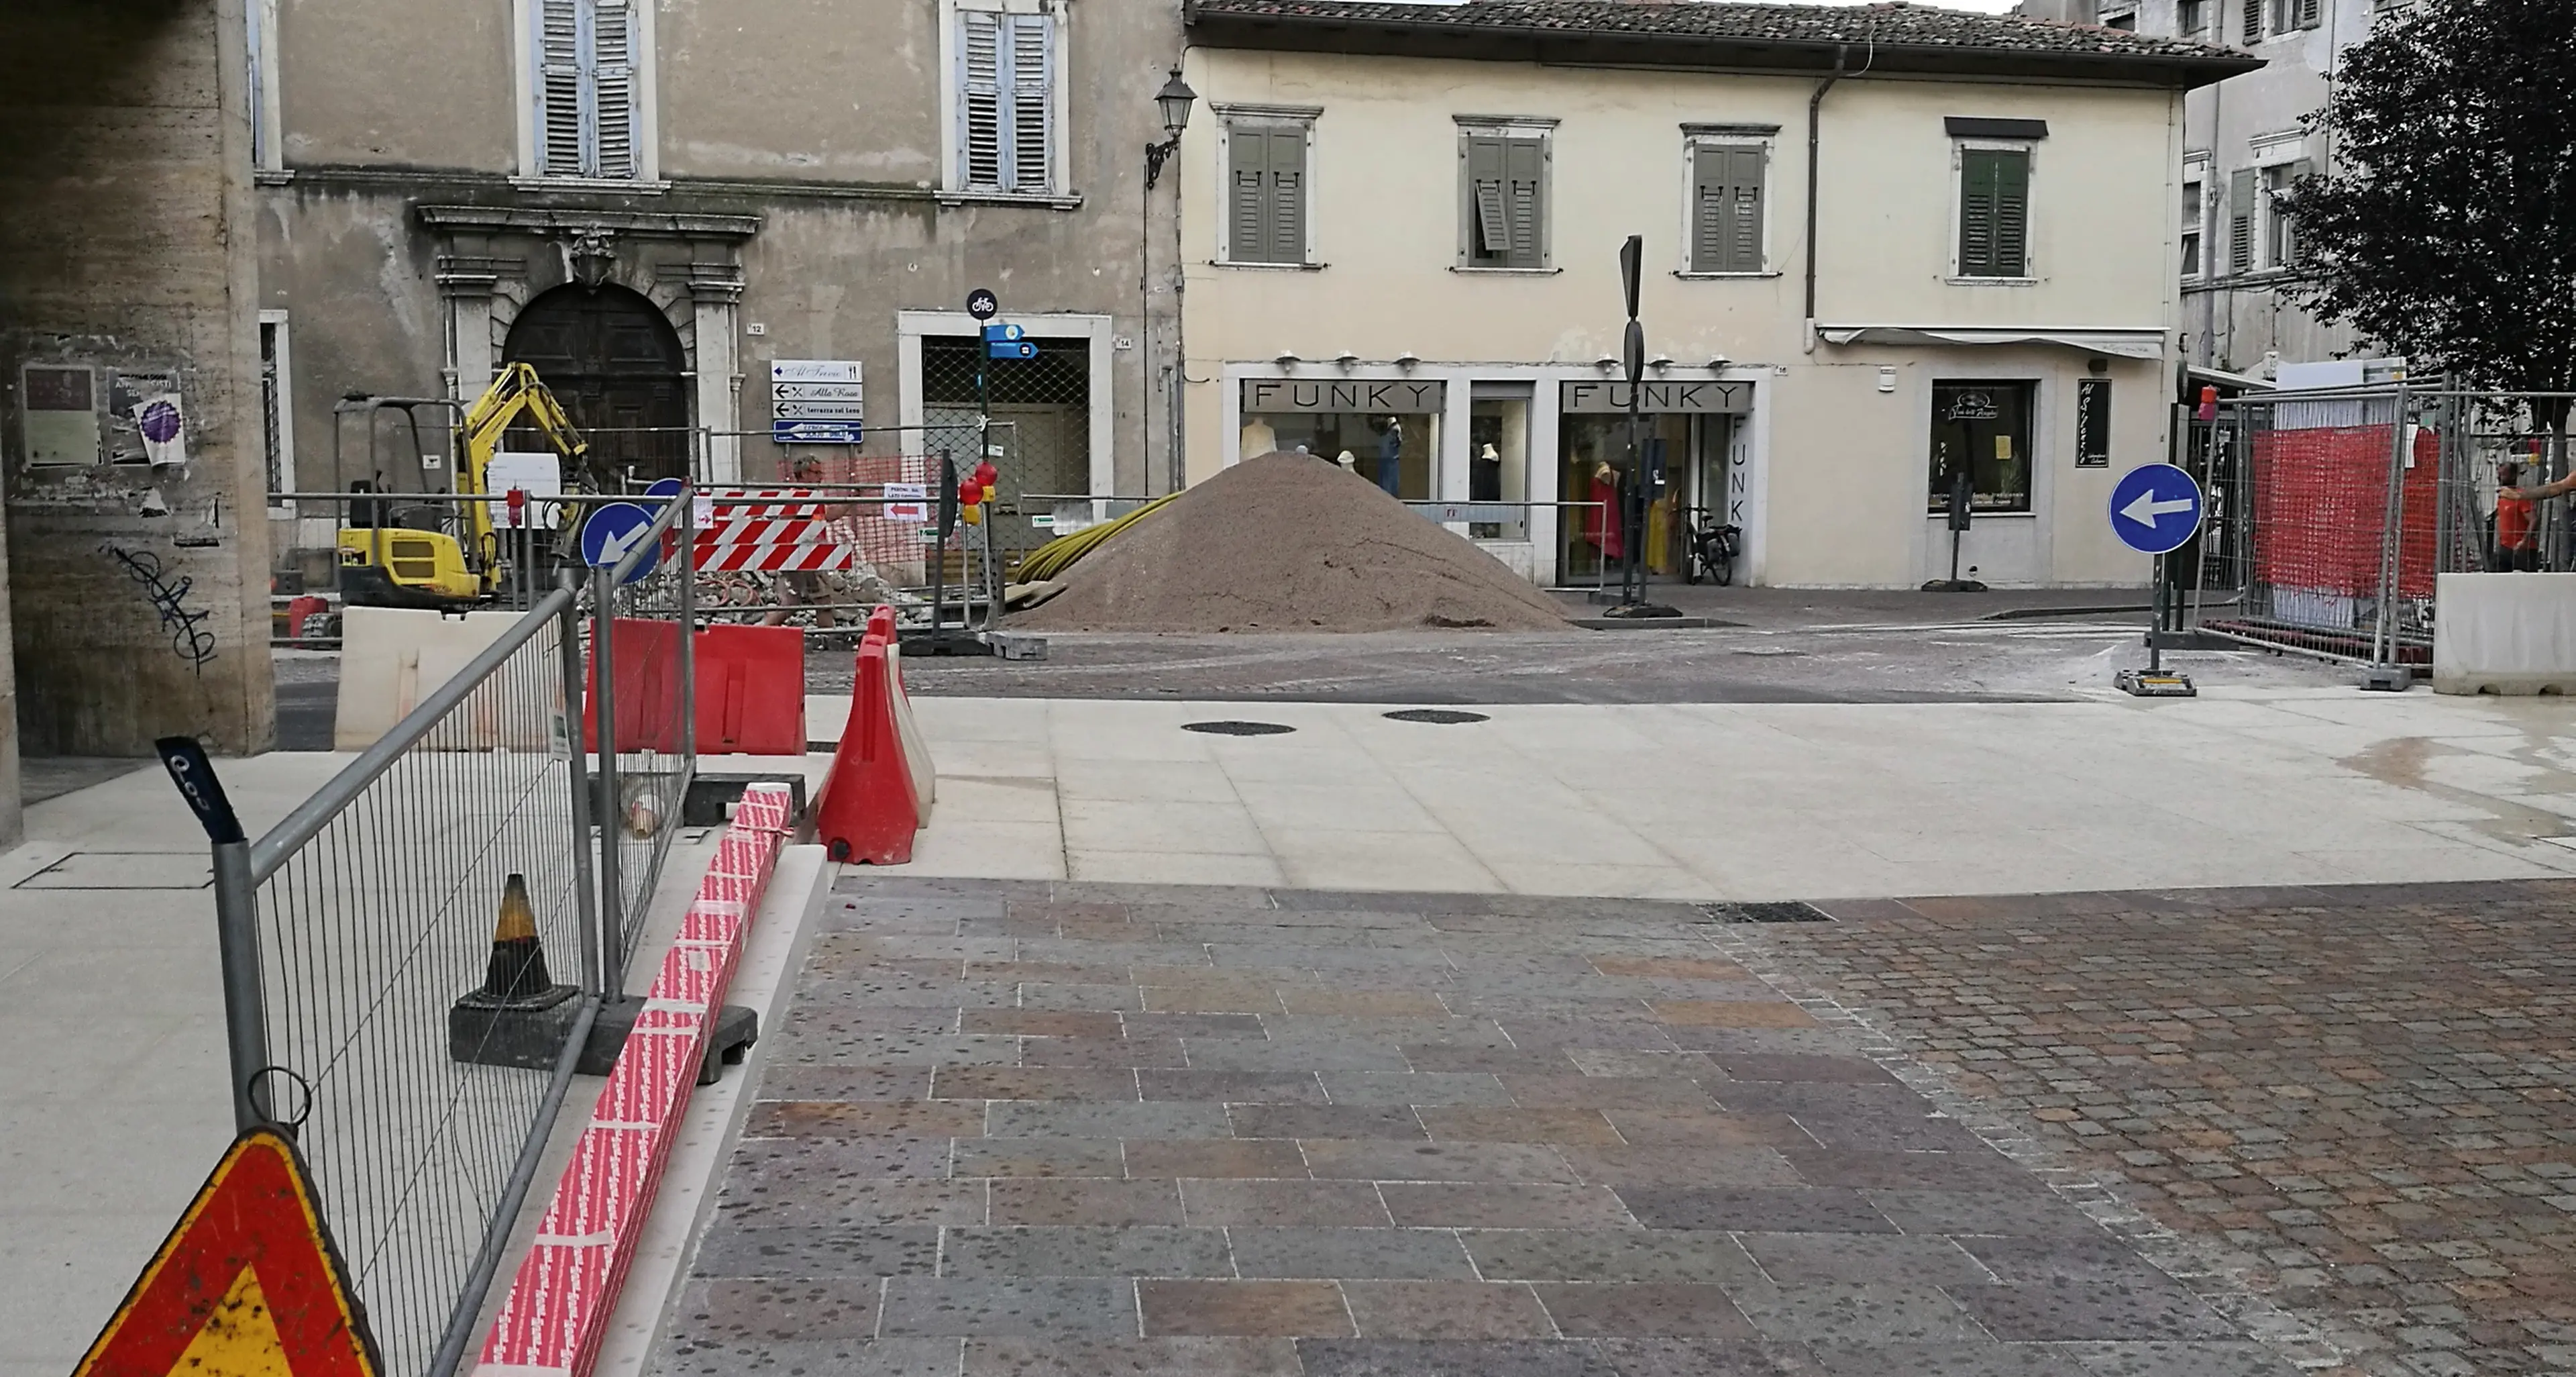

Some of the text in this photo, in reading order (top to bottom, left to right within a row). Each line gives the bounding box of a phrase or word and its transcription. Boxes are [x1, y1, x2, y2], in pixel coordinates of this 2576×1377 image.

[752, 325, 761, 333] 12
[1256, 385, 1429, 408] FUNKY
[1574, 386, 1738, 408] FUNKY
[1731, 416, 1747, 521] FUNK
